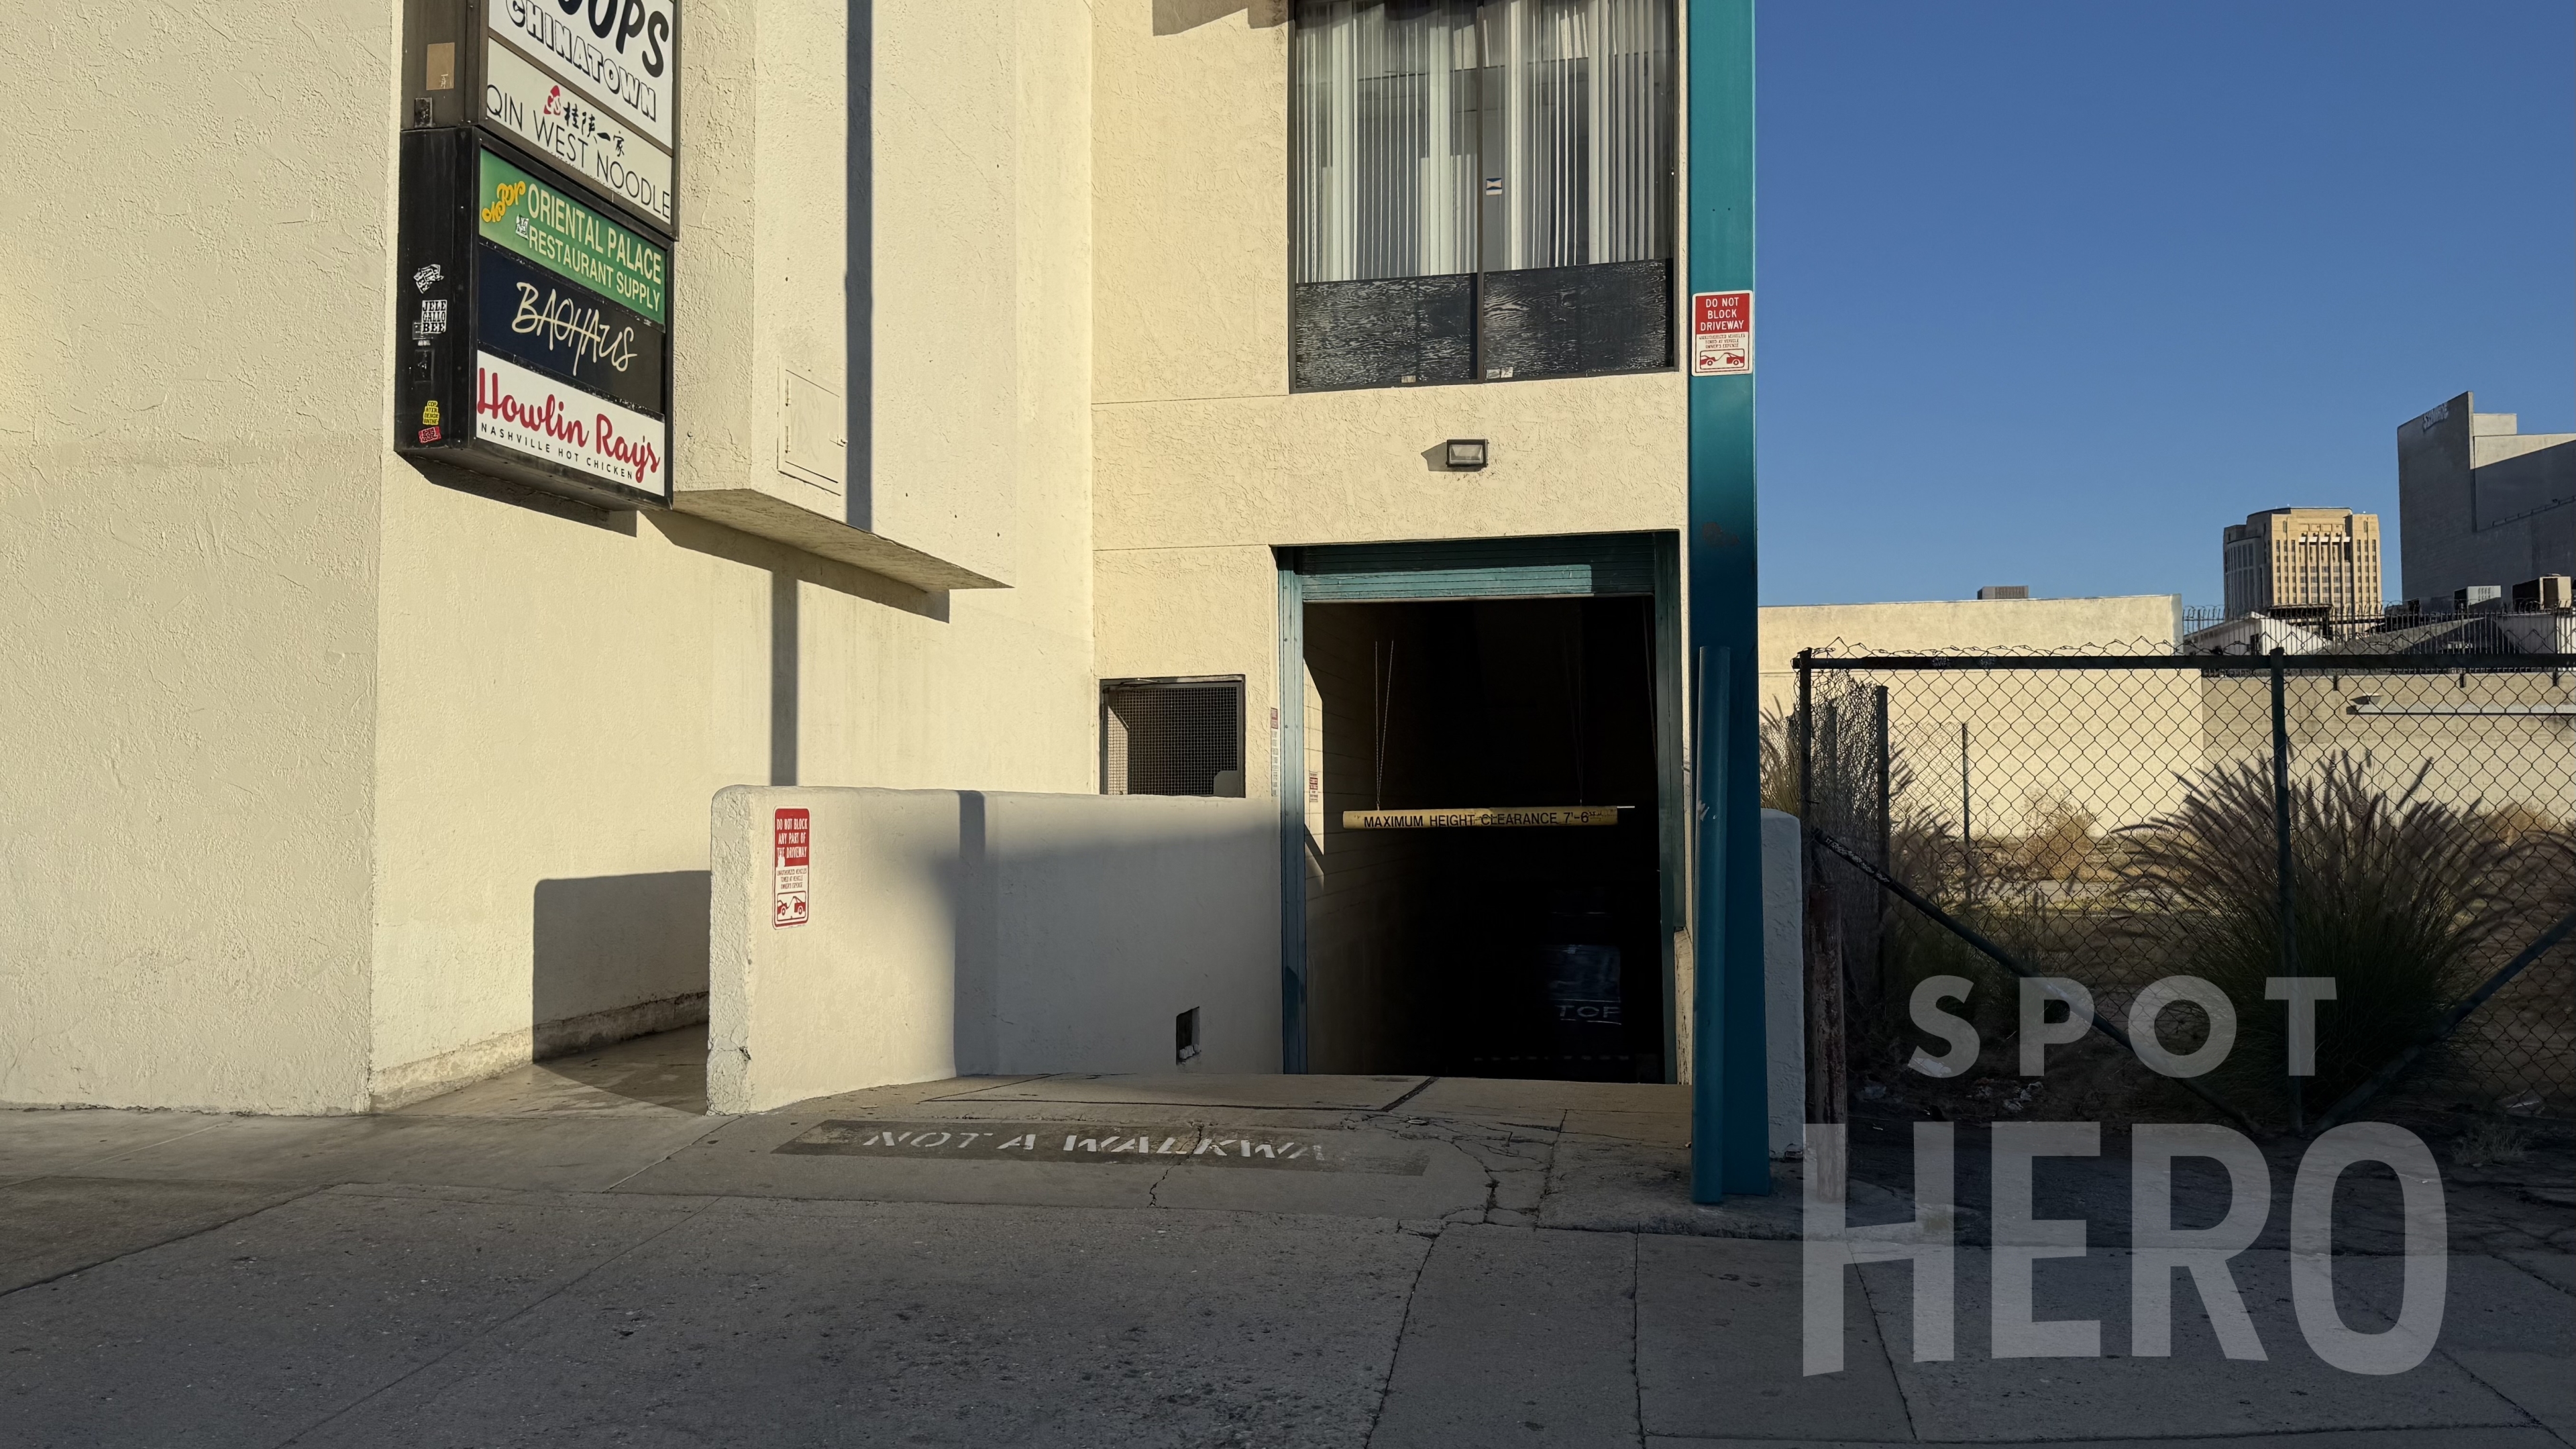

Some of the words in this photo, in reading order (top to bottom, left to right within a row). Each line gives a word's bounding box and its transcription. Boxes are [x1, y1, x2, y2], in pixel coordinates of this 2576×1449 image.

[557, 0, 669, 78] OPS
[506, 0, 656, 122] CHINATOWN
[487, 85, 523, 131] QIN
[533, 110, 588, 168] WEST
[597, 150, 669, 219] NOODLE
[528, 184, 603, 254] ORIENTAL
[608, 227, 661, 284] PALACE
[529, 225, 614, 288] RESTAURANT
[616, 271, 660, 312] SUPPLY
[423, 301, 446, 311] JELE
[1706, 299, 1717, 308] DO
[1722, 297, 1739, 307] NOT
[1707, 309, 1737, 319] BLOCK
[422, 322, 445, 333] BEE
[512, 282, 637, 376] BAOHAUS
[1701, 320, 1744, 331] DRIVEWAY
[477, 367, 590, 447] Howlin
[596, 413, 660, 483] Ray's
[481, 423, 550, 453] NASHVILLE
[558, 447, 579, 462] HOT
[586, 458, 633, 480] CHICKEN
[777, 818, 783, 830] DO
[784, 818, 792, 830] NOT
[794, 818, 808, 830] BLOCK
[1364, 815, 1423, 828] MAXIMUM
[1430, 814, 1475, 826] HEIGHT
[1481, 812, 1558, 825] CLEARANCE
[778, 833, 787, 845] ANY
[789, 833, 799, 844] PART
[800, 832, 806, 844] OF
[786, 846, 807, 859] DRIVEWAY
[863, 1131, 994, 1148] NOT
[996, 1134, 1036, 1150] A
